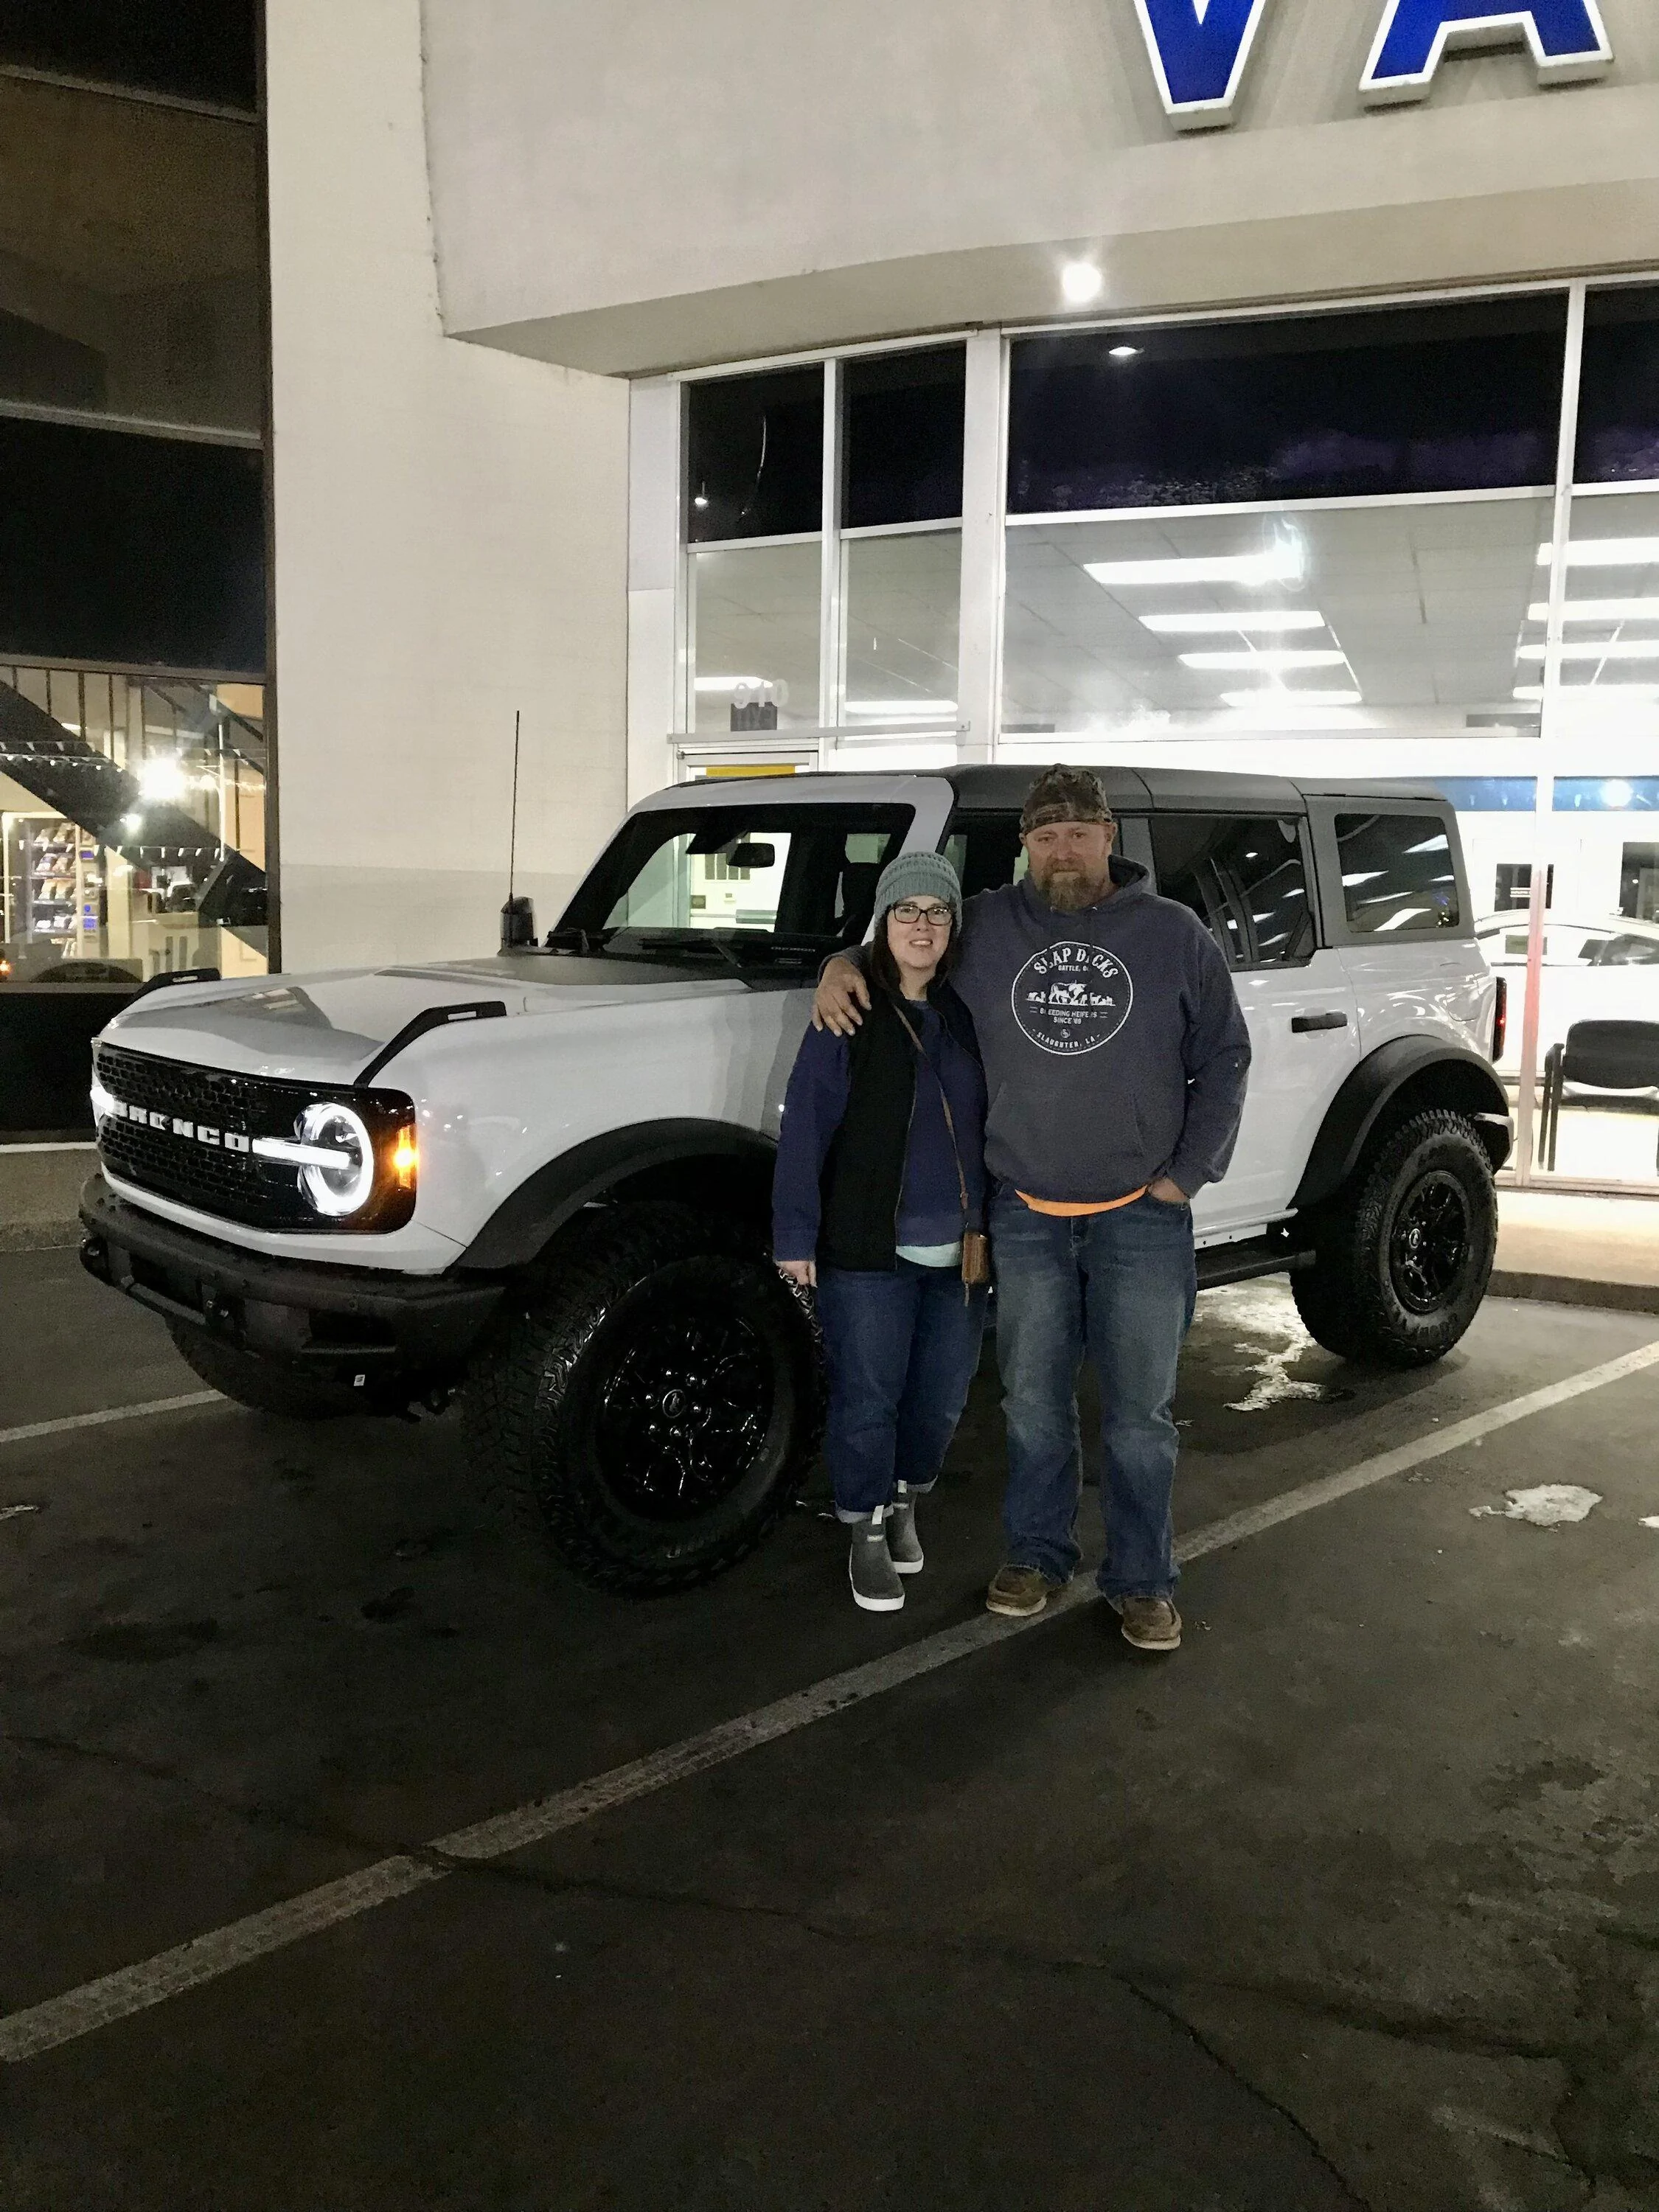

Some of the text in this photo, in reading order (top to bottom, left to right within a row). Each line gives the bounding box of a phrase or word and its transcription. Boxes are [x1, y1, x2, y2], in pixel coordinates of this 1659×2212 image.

[734, 679, 788, 709] 910
[1034, 947, 1071, 974] SLAP
[1040, 1007, 1070, 1017] BEEDING
